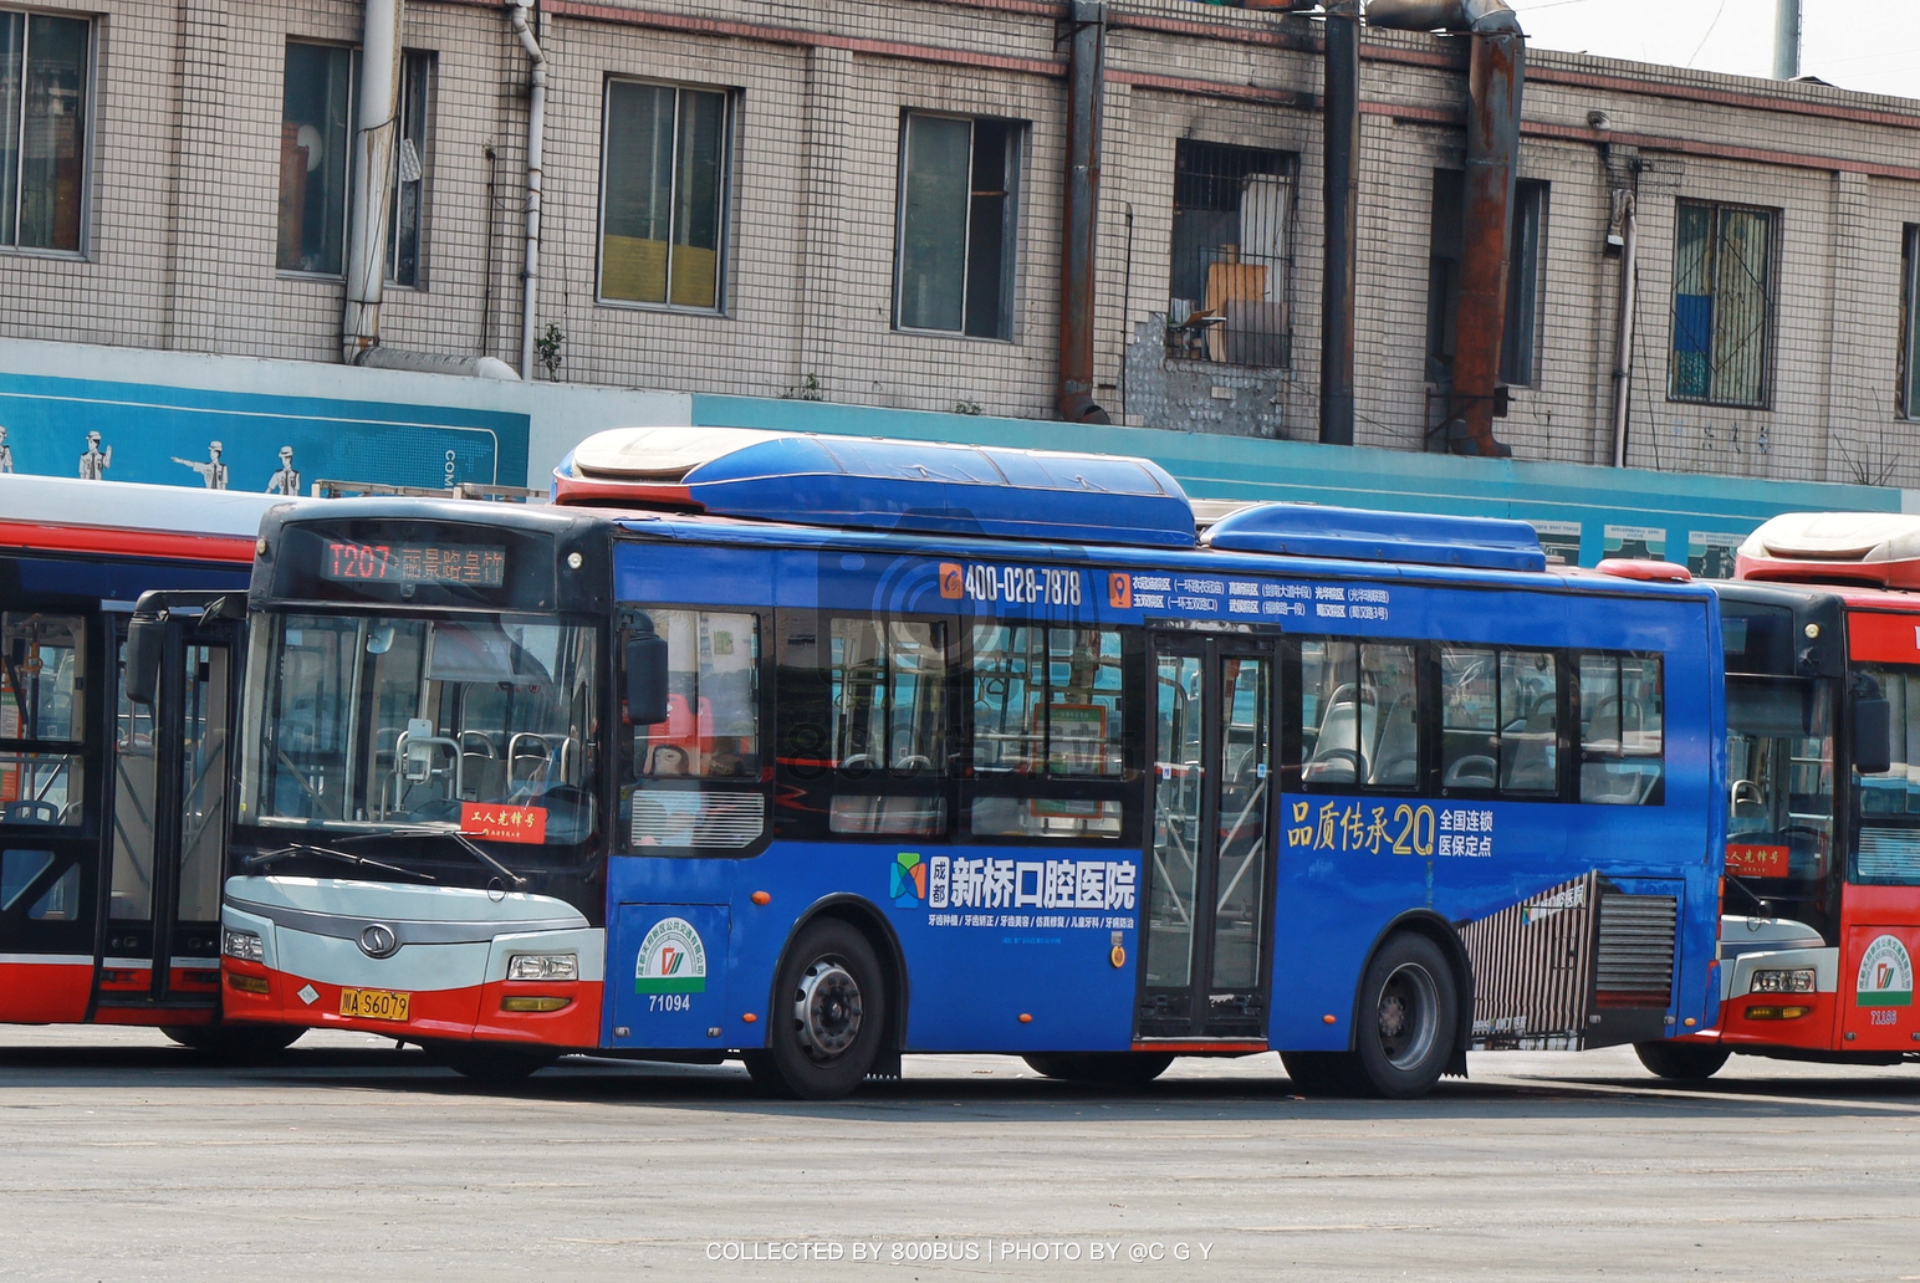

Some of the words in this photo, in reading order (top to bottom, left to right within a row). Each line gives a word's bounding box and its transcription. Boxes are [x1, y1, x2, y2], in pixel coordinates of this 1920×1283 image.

[444, 449, 456, 491] COM
[329, 544, 390, 578] T207
[965, 565, 1081, 606] 400-028-7878
[471, 810, 535, 828] 工人先锋号
[1439, 808, 1493, 832] 全国连锁
[1438, 834, 1492, 857] 医保定点
[1725, 849, 1778, 864] 人先锋号
[932, 861, 946, 904] 成都
[950, 857, 1136, 910] 新桥口腔医院
[649, 994, 690, 1012] 71094
